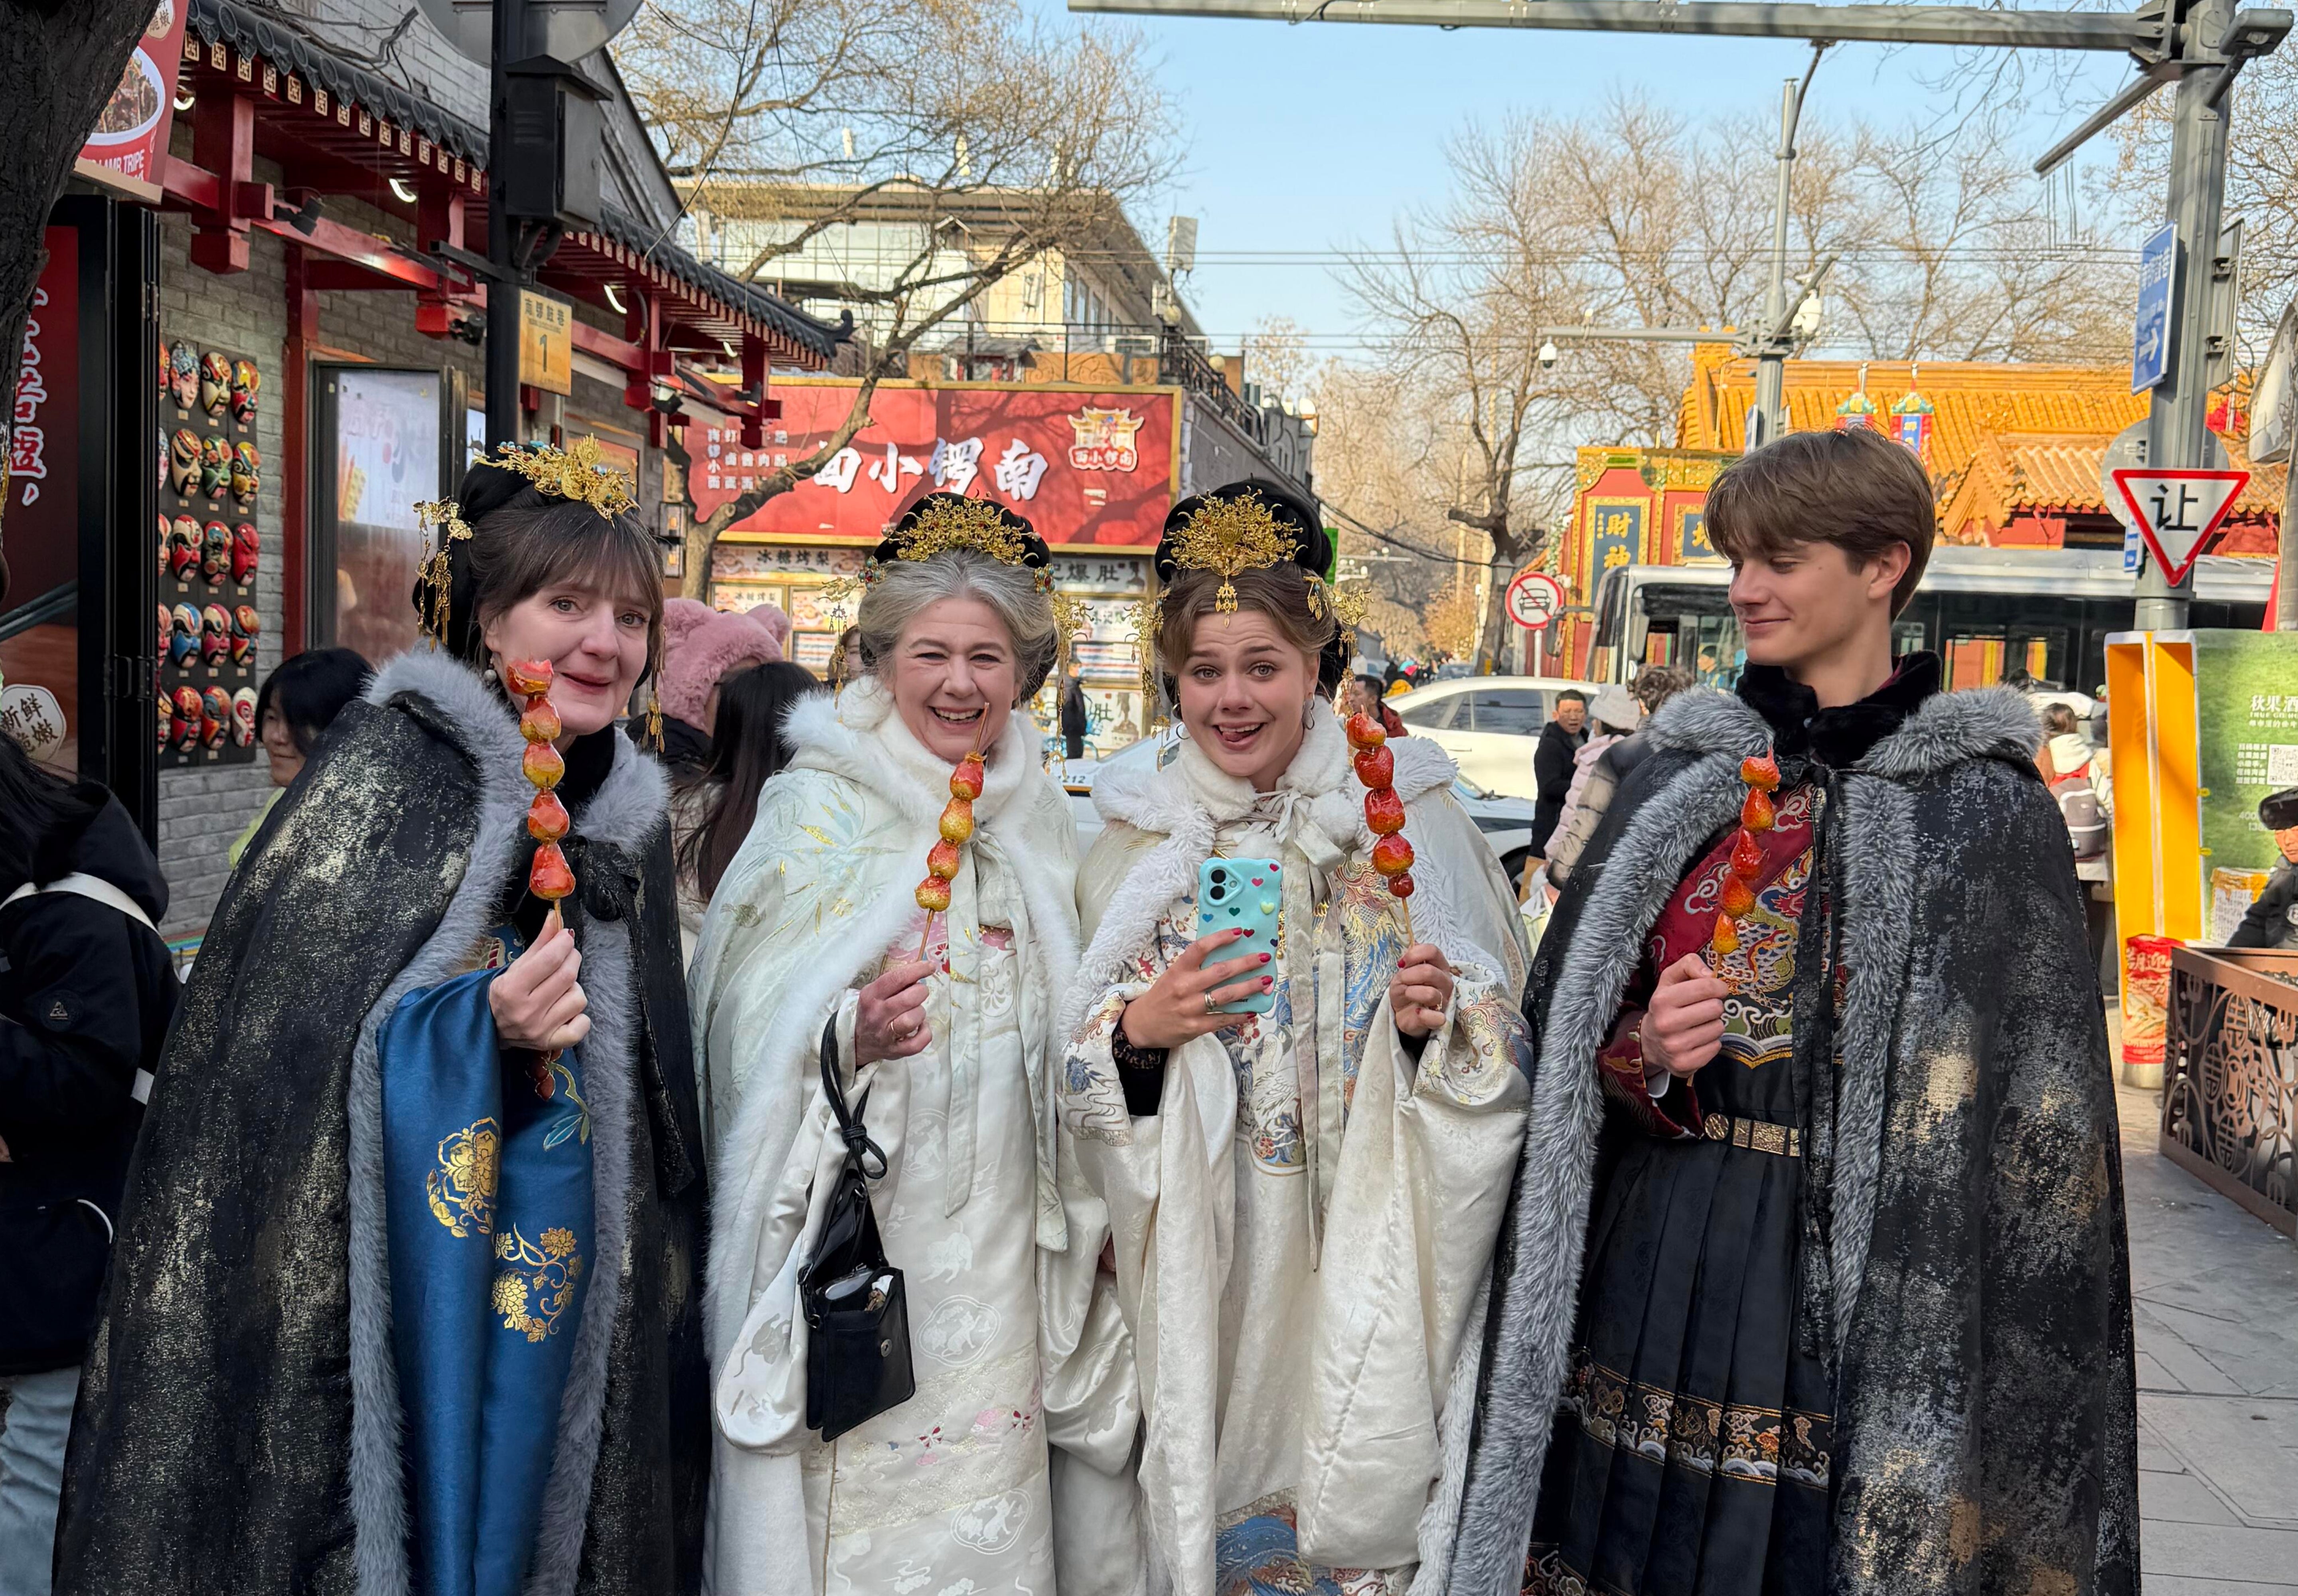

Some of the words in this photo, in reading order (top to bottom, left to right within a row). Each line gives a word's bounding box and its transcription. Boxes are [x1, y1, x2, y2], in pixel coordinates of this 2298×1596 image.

[124, 149, 145, 174] TRIPE
[540, 334, 547, 372] 1
[2150, 483, 2198, 531] 让
